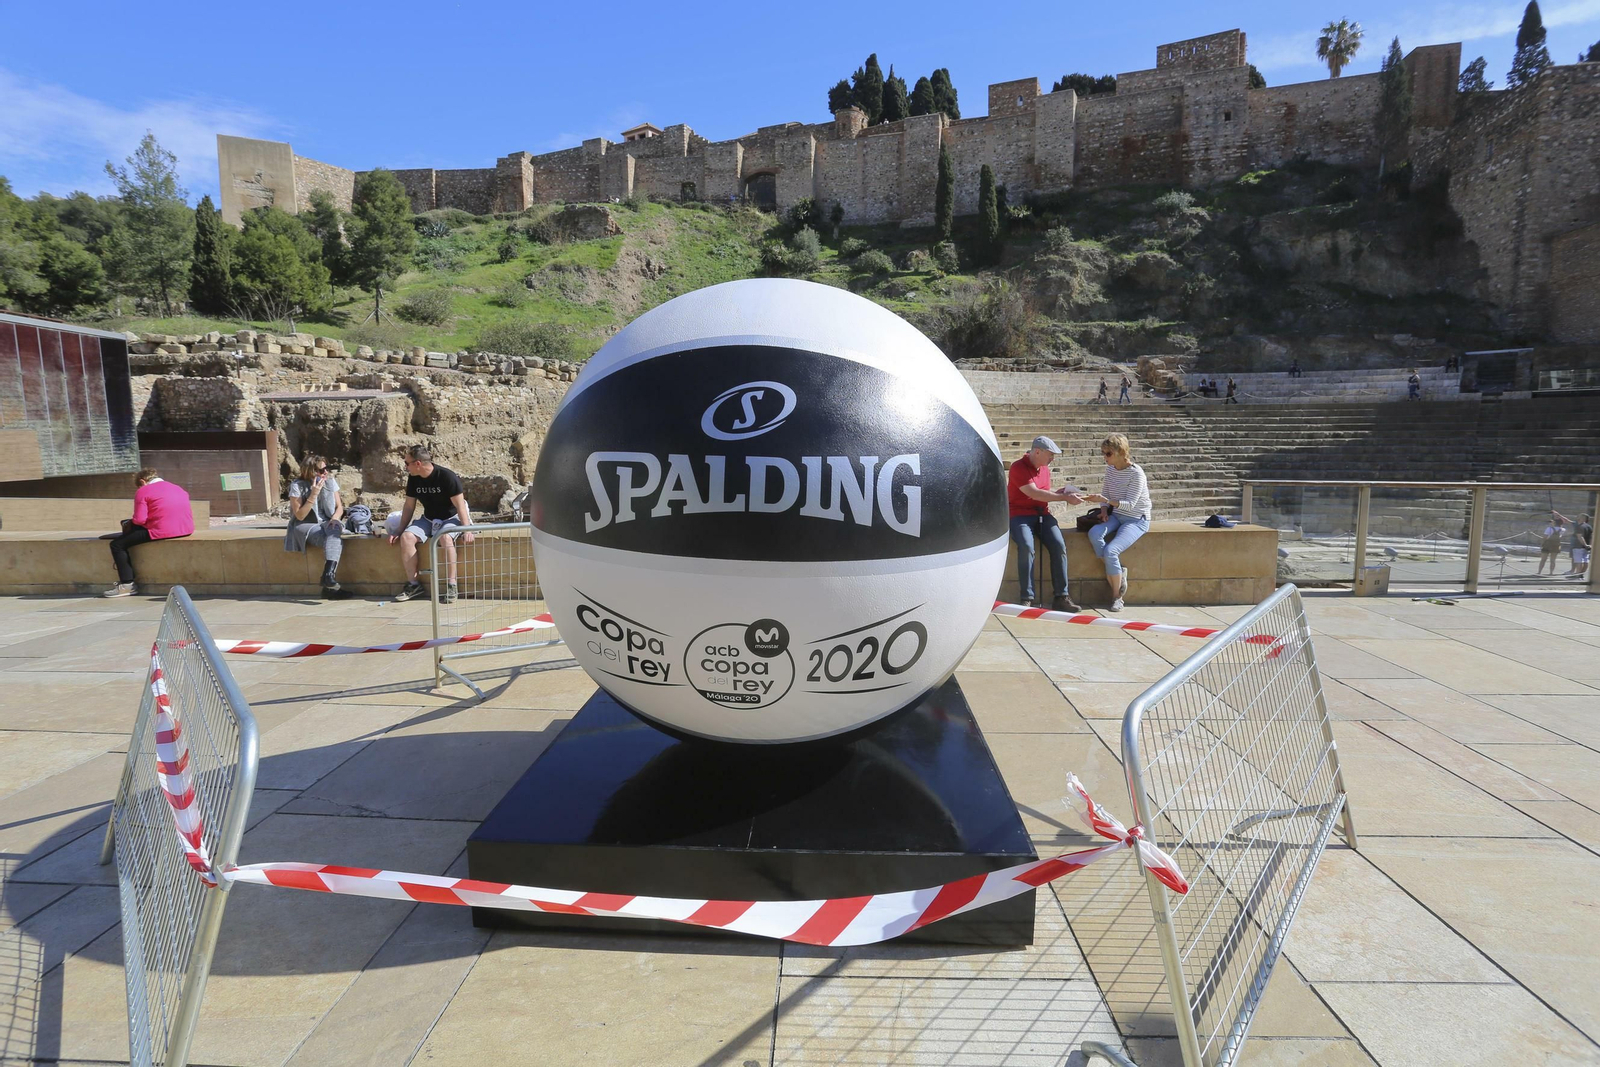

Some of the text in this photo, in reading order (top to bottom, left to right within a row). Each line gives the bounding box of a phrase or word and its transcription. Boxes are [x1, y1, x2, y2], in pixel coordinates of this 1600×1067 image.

[732, 390, 765, 429] S
[584, 451, 921, 538] SPALDING
[587, 639, 671, 682] del rey
[705, 644, 740, 658] acb
[806, 621, 928, 682] 2020
[700, 658, 769, 677] copa
[706, 692, 742, 702] Málaga
[707, 676, 775, 695] del rey
